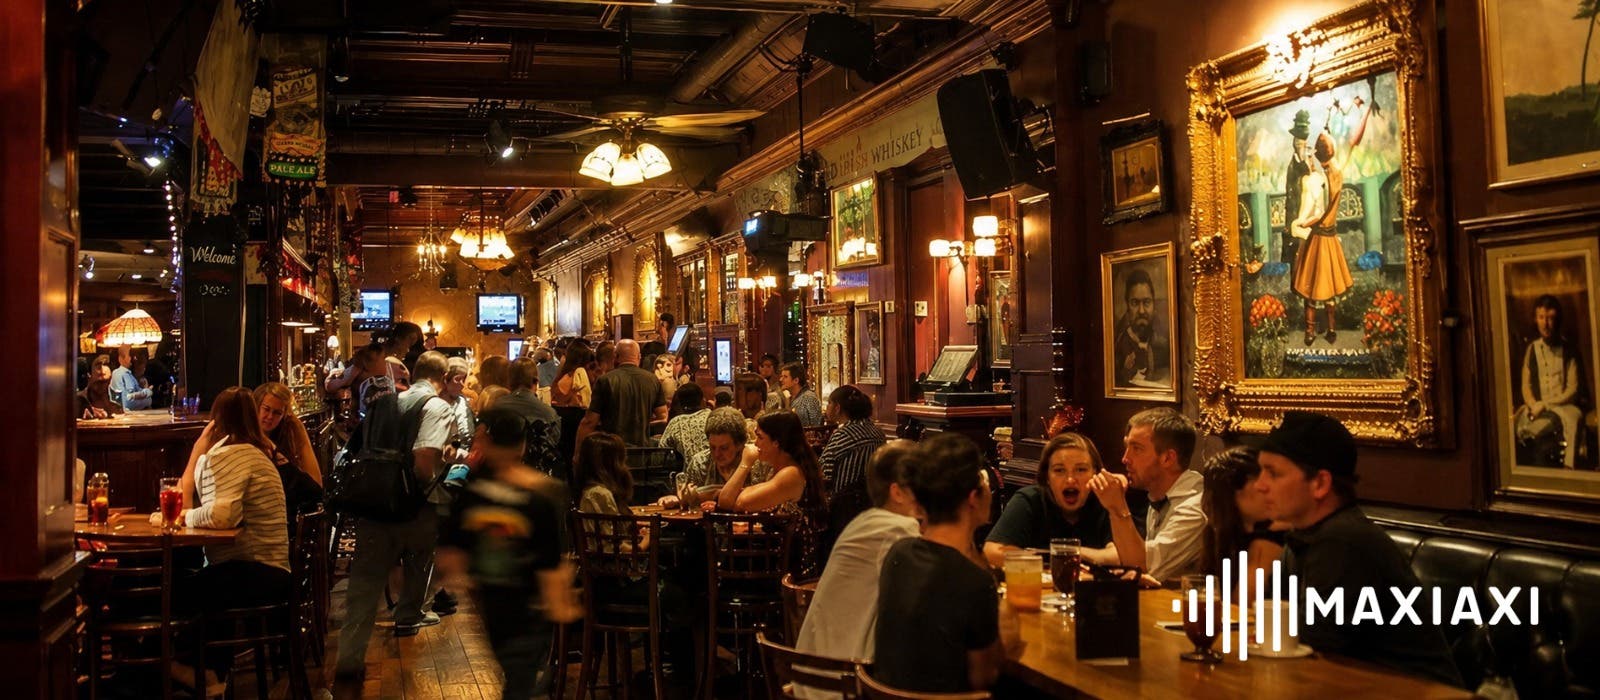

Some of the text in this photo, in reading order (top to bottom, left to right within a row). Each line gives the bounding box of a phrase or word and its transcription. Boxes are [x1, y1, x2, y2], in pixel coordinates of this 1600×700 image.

[871, 127, 922, 164] WHISKEY
[270, 164, 317, 175] PALE ALE
[190, 245, 237, 265] Welcome
